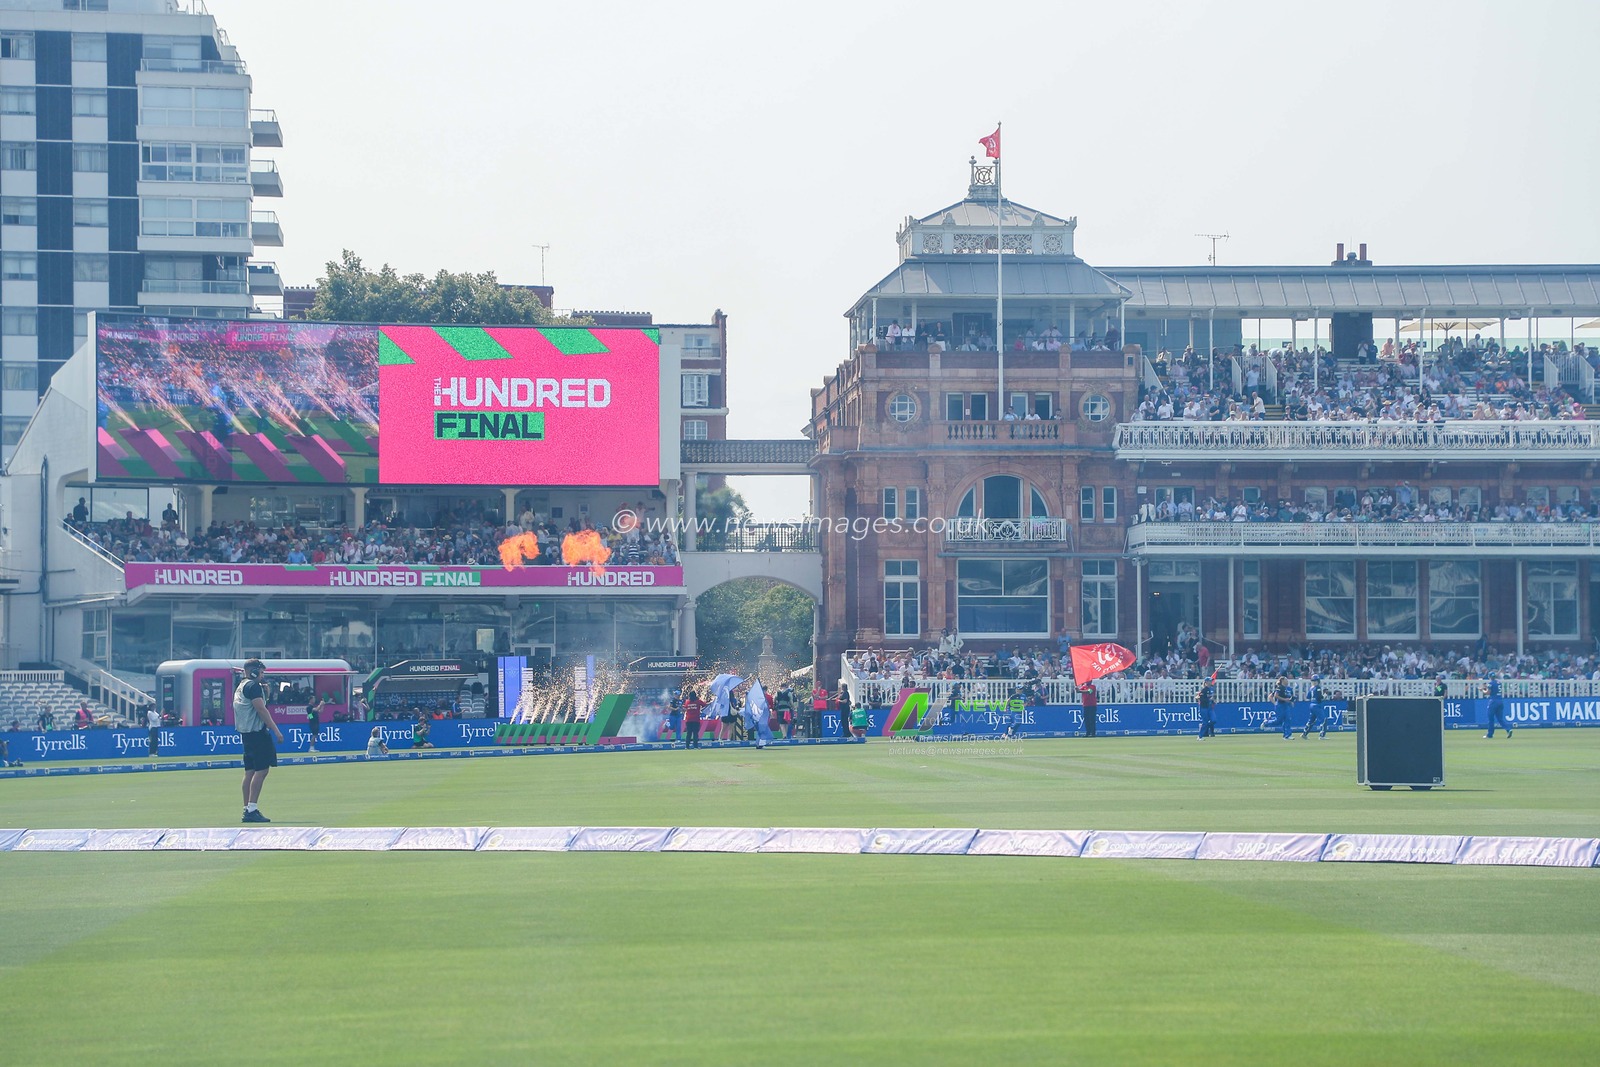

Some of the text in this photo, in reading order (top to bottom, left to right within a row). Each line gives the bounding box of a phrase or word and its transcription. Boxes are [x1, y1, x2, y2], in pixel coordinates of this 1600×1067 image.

[434, 377, 611, 407] HUNDRED
[436, 413, 542, 439] FINAL
[155, 569, 243, 585] HUNDRED
[330, 571, 418, 586] HUNDRED
[421, 571, 481, 586] FINAL
[568, 571, 655, 586] HUNDRED
[275, 706, 286, 715] sky
[1505, 701, 1550, 721] JUST
[201, 730, 244, 752] Tyrrel
[375, 724, 417, 746] Tyrrel
[1235, 841, 1286, 854] SIMPLES
[1498, 847, 1558, 860] SIMPLES
